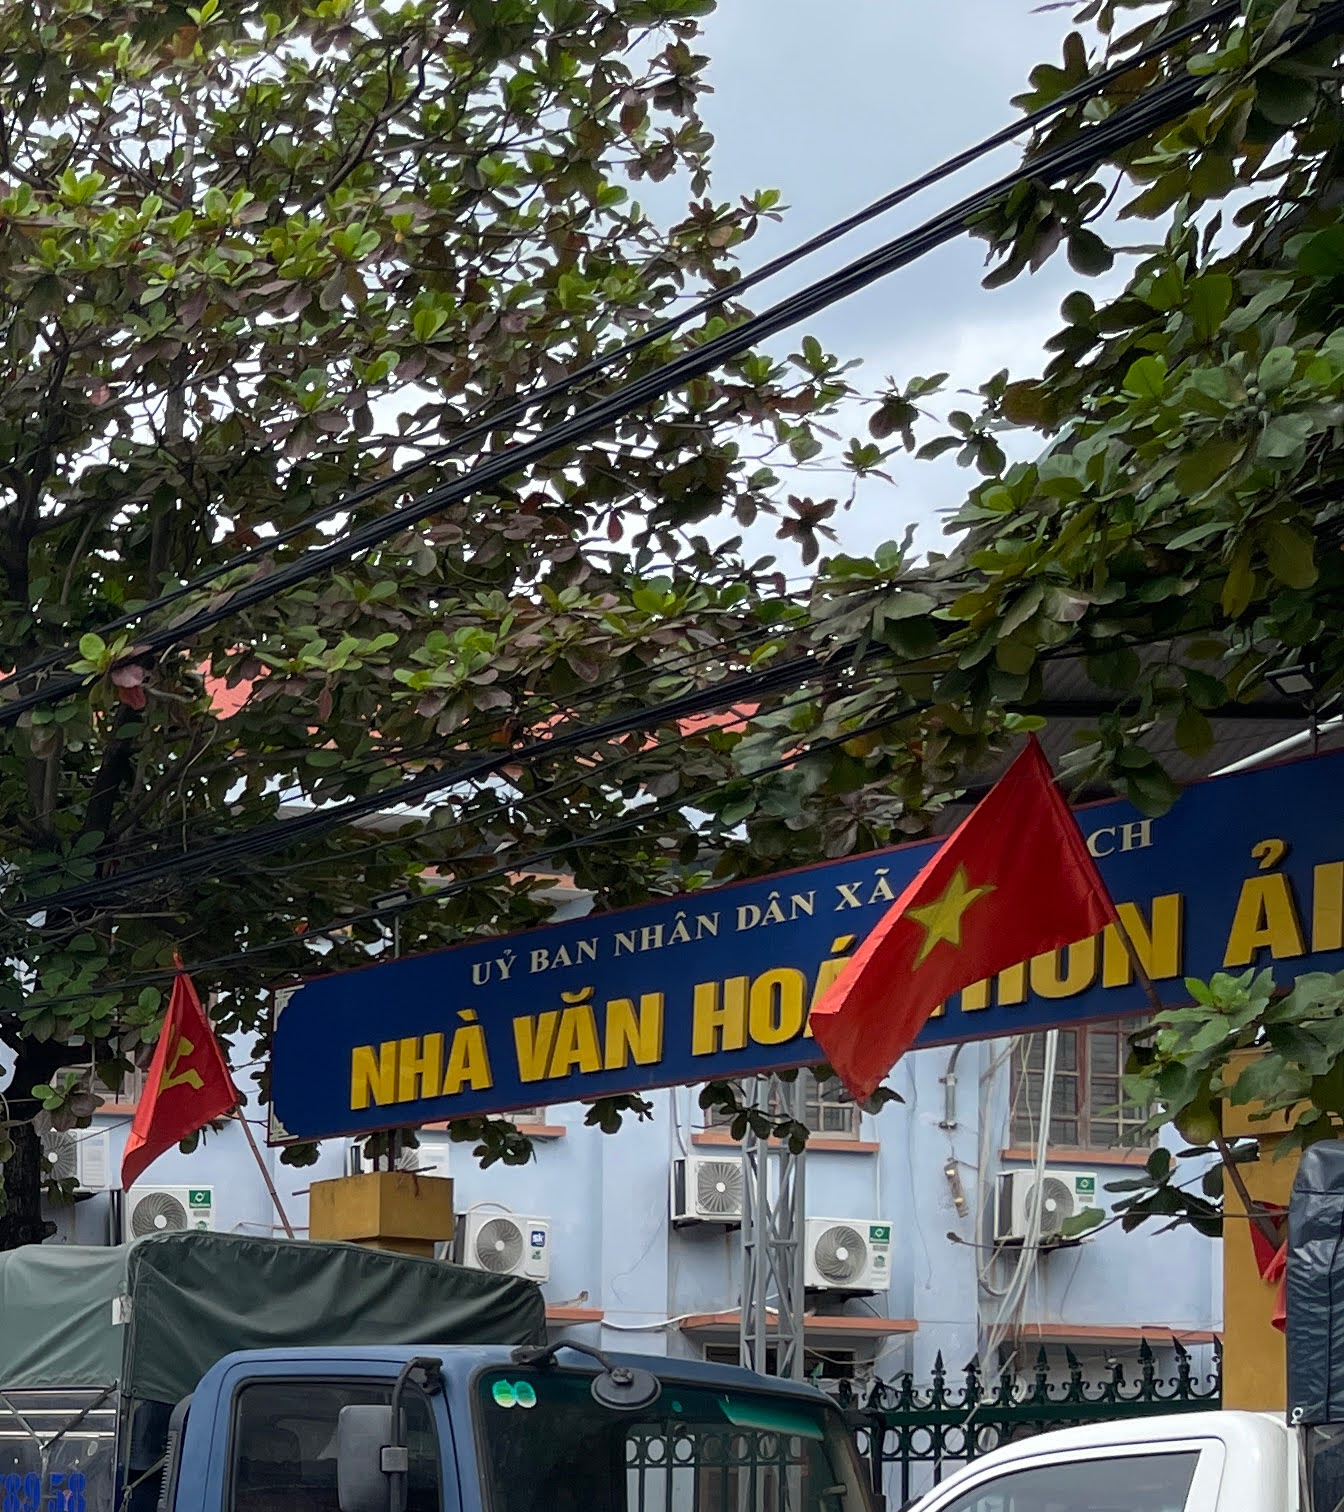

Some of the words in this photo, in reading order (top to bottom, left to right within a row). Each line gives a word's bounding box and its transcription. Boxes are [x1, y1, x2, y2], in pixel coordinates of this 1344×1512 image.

[528, 937, 601, 974] BAN
[614, 910, 721, 957] NHÂN
[736, 890, 817, 931] DÂN
[834, 868, 896, 911] XÃ
[350, 1009, 494, 1110] NHÀ
[513, 986, 665, 1083] VĂN
